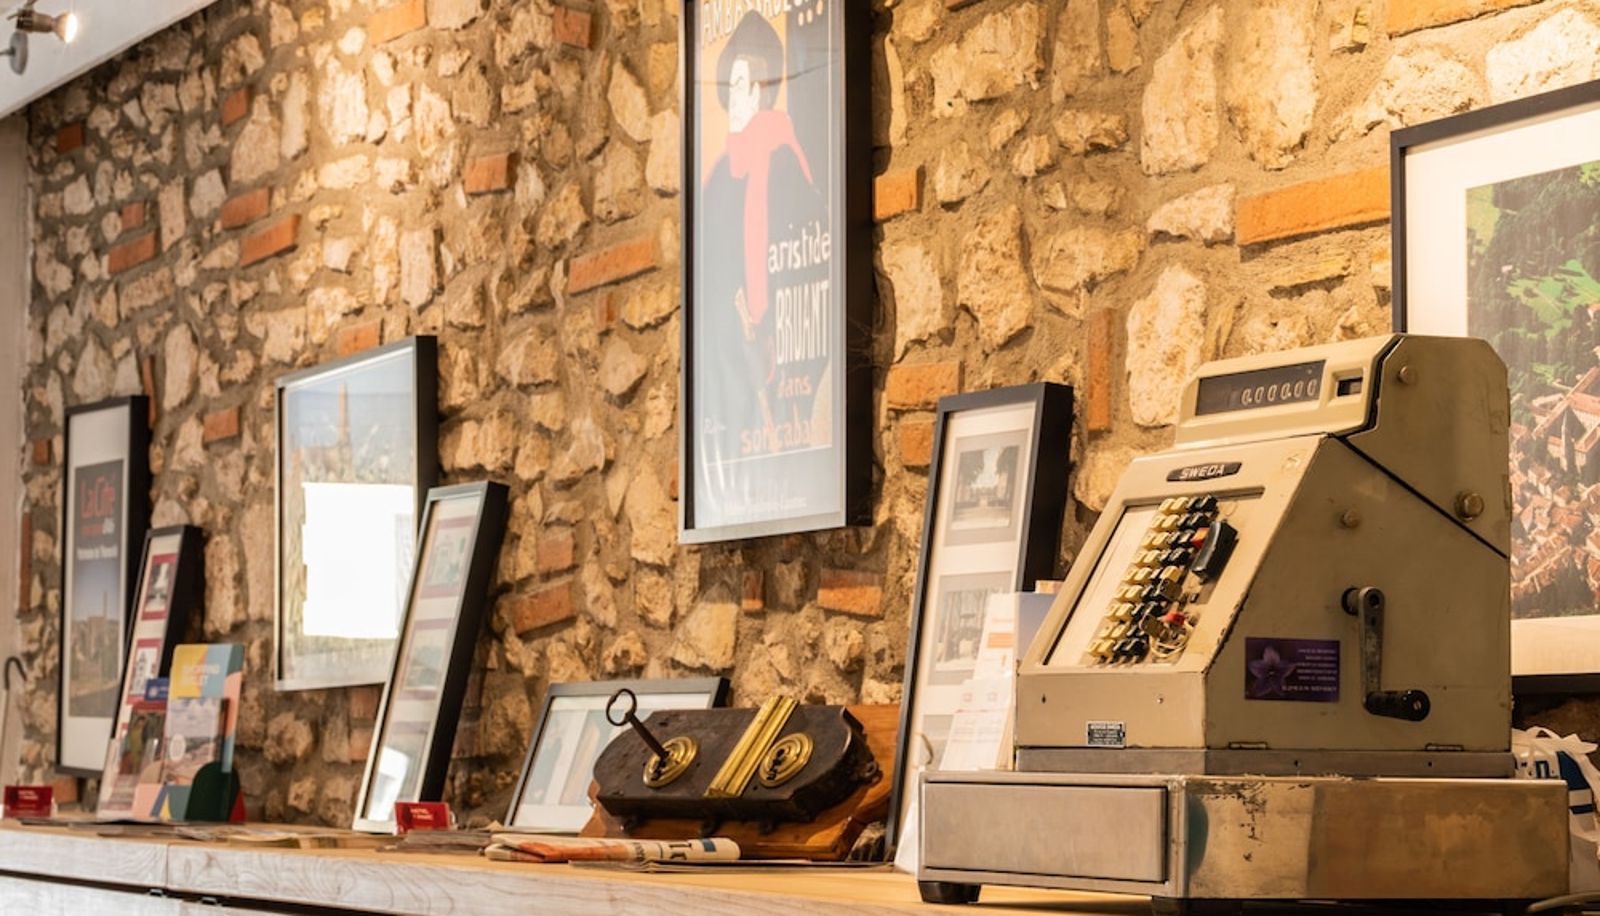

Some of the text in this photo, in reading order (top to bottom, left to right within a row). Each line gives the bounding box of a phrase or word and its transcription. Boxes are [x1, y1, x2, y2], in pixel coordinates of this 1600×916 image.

[767, 220, 831, 273] aristide
[775, 279, 829, 365] BRUANT
[1179, 464, 1225, 480] SWEDA
